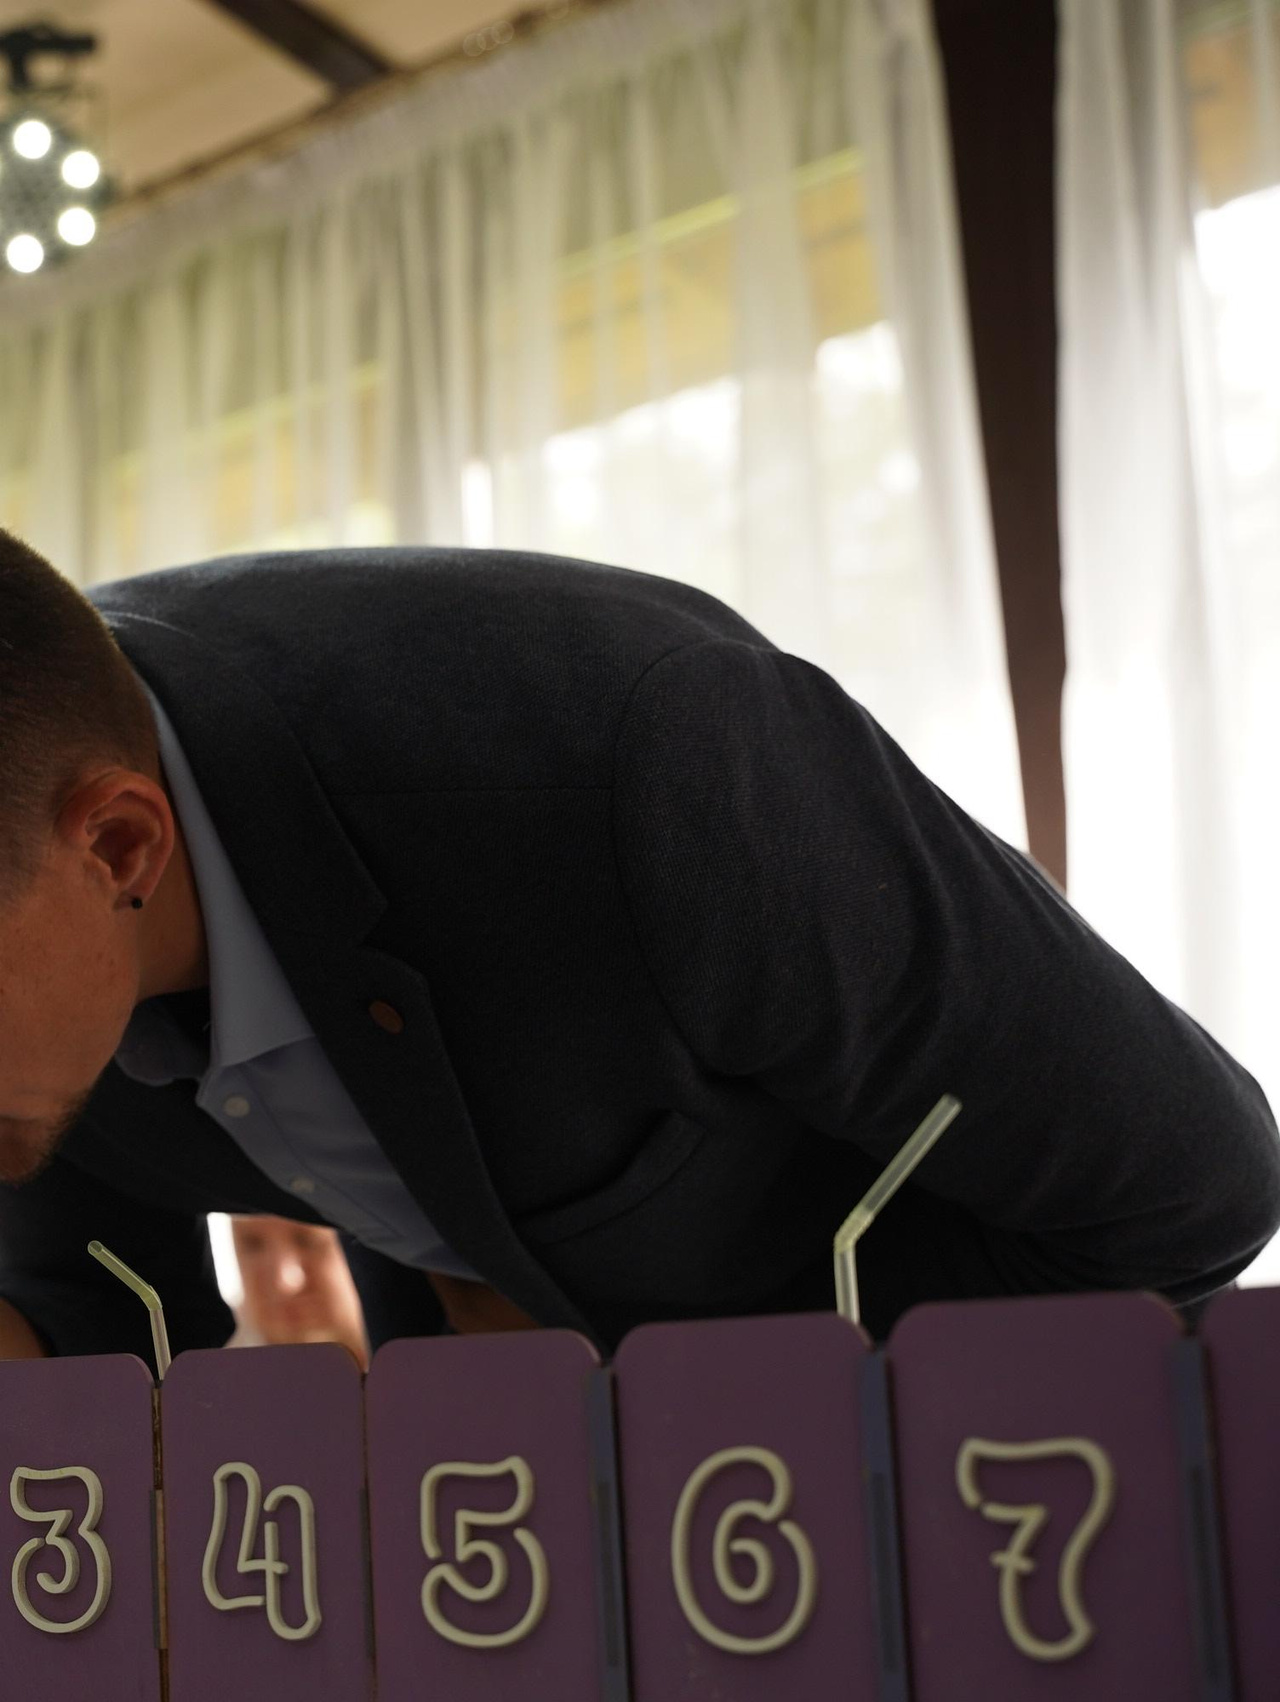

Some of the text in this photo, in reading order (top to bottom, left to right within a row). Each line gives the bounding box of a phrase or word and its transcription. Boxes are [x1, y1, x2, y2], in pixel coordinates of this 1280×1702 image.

[9, 1466, 111, 1634] 3
[201, 1461, 322, 1640] 4
[420, 1456, 546, 1647] 5
[671, 1446, 814, 1652] 6
[956, 1437, 1115, 1660] 7
